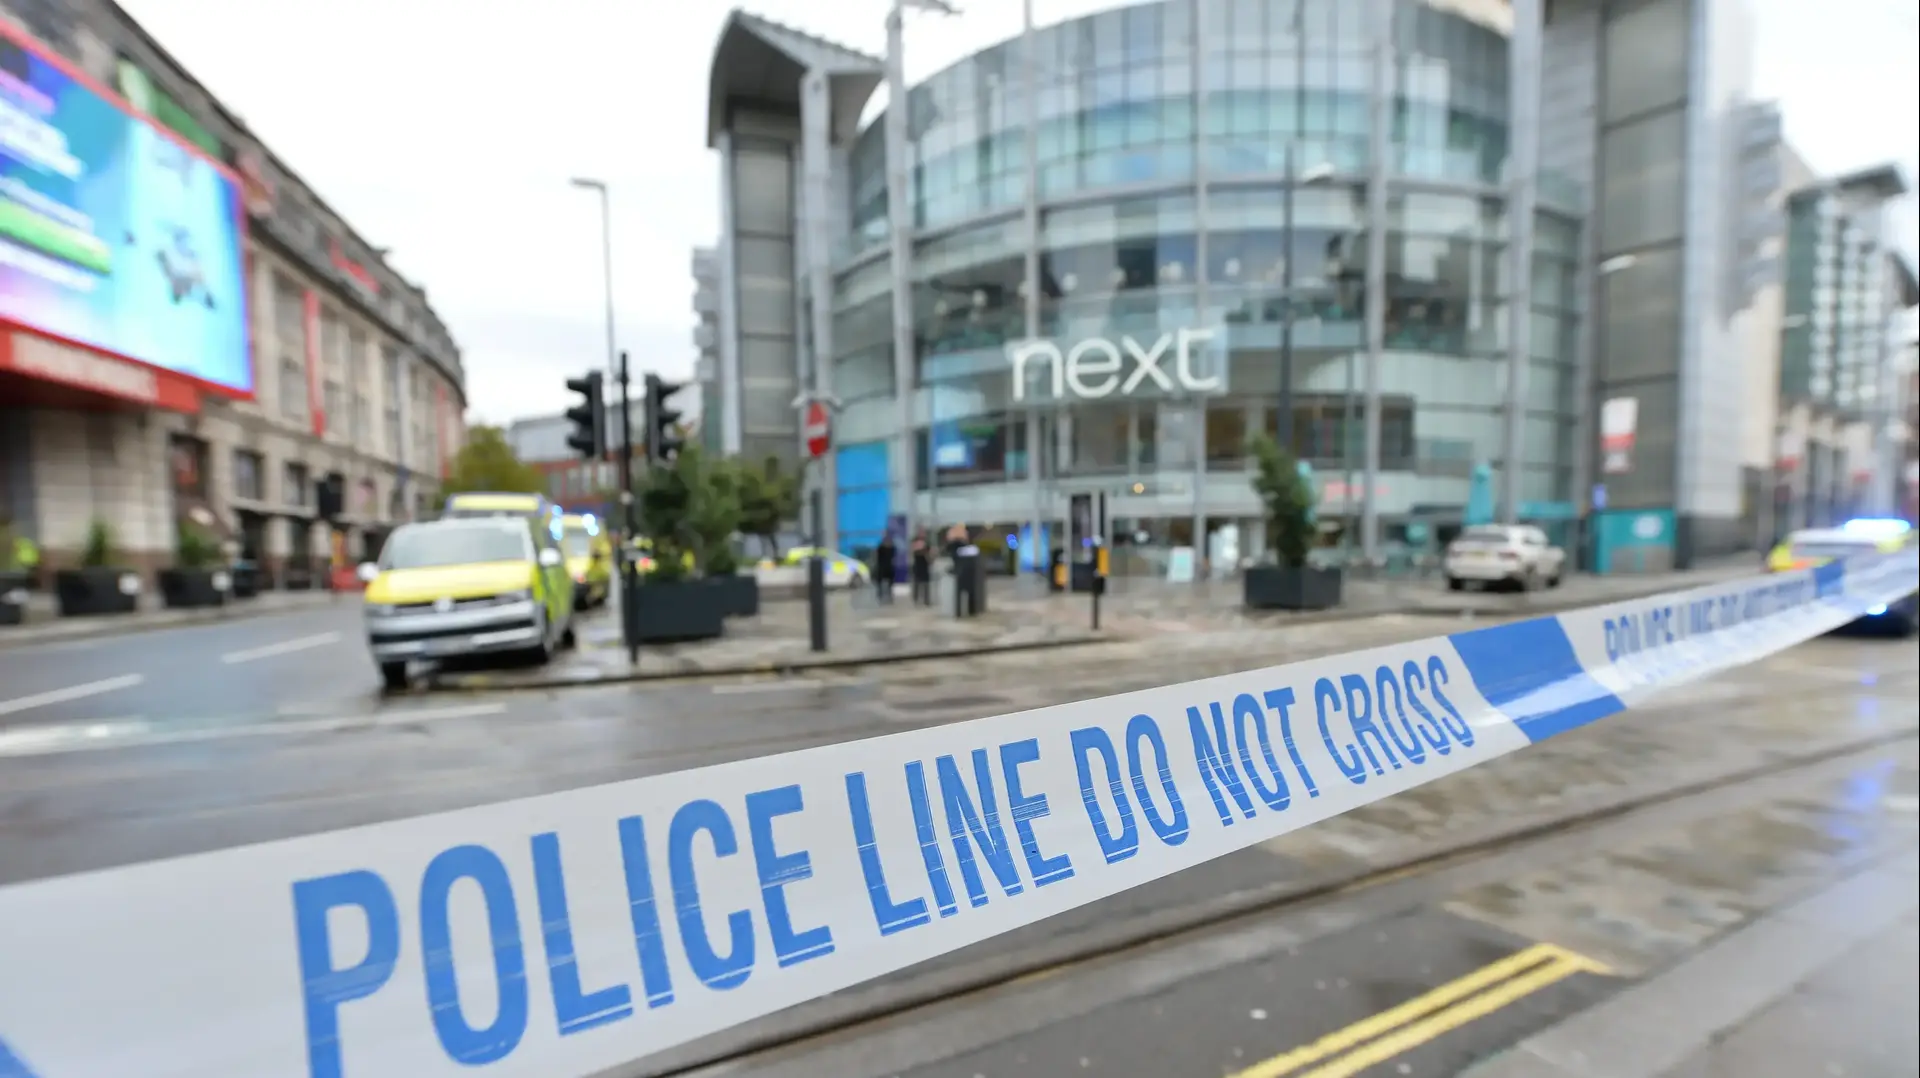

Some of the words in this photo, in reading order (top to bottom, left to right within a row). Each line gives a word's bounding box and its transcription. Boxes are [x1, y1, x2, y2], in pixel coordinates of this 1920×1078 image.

[1010, 327, 1220, 402] next
[292, 783, 835, 1078] POLICE
[846, 738, 1076, 936] LINE
[1072, 714, 1190, 864] DO
[1186, 687, 1320, 826] NOT
[1314, 655, 1474, 785] CROSS
